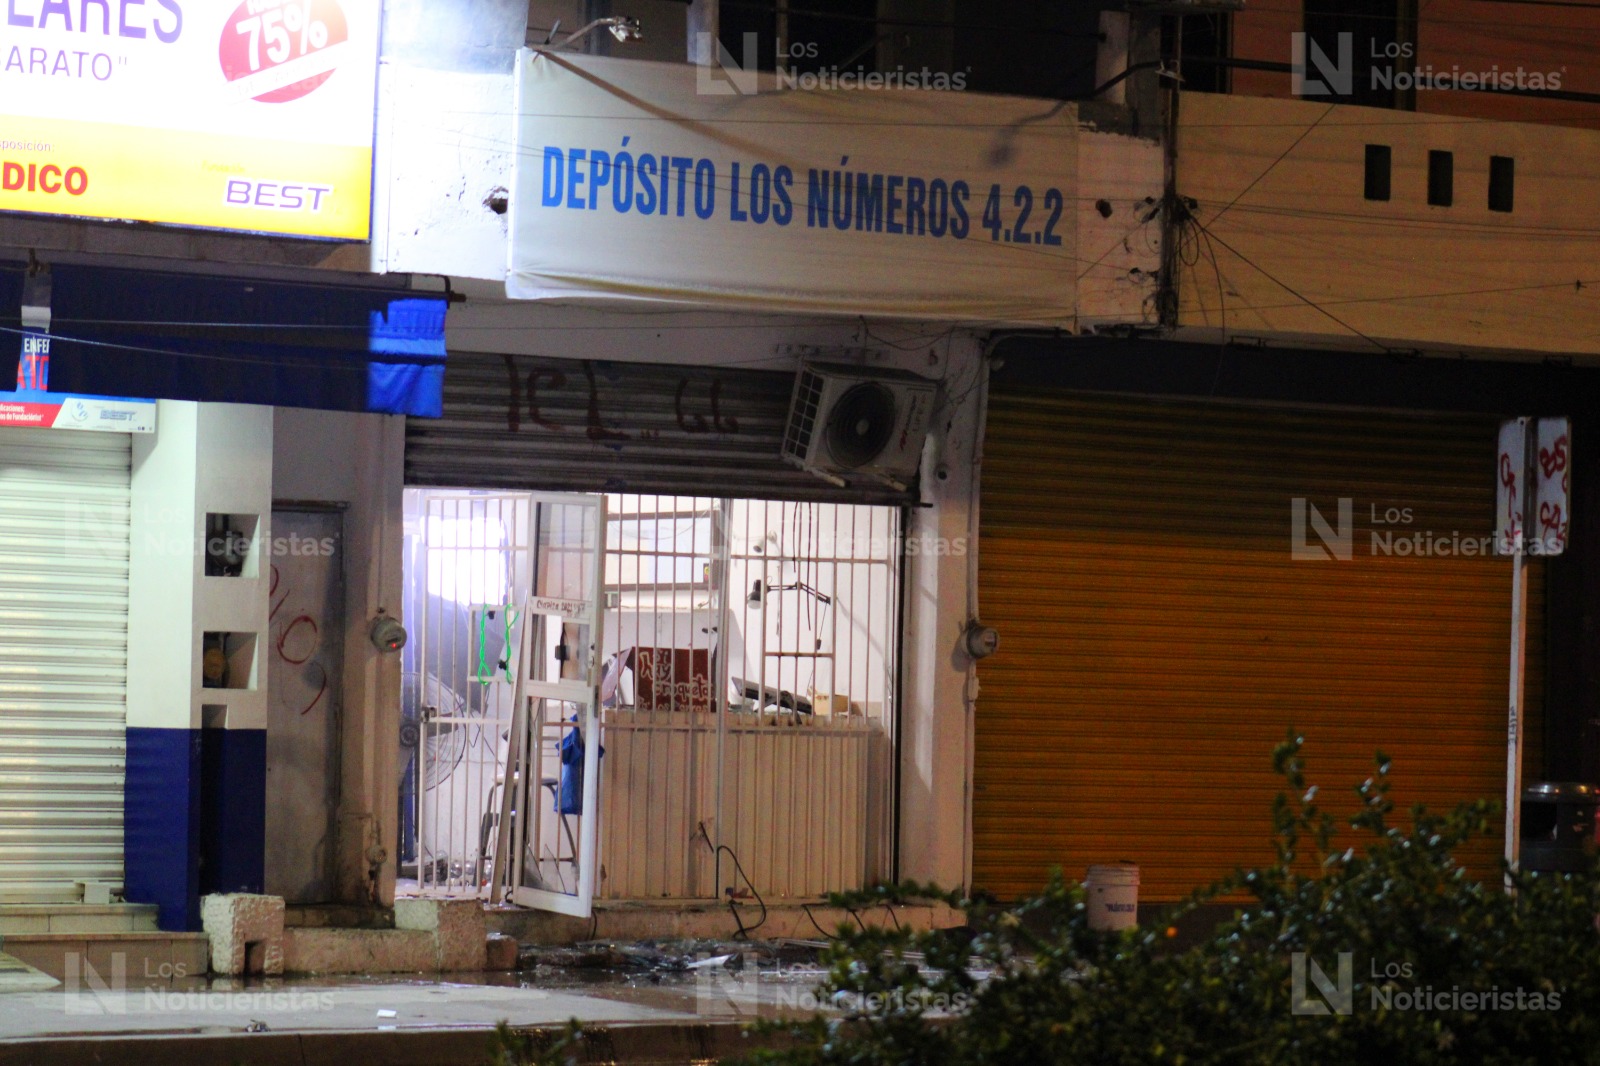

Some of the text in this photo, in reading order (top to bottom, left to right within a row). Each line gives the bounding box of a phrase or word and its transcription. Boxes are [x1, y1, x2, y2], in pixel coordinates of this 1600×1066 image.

[237, 2, 329, 72] 75%
[0, 45, 128, 81] ARATO"
[2, 161, 89, 197] DICO
[226, 179, 331, 211] BEST
[541, 135, 1064, 247] DEPÓSITO LOS NÚMEROS 4.2.2
